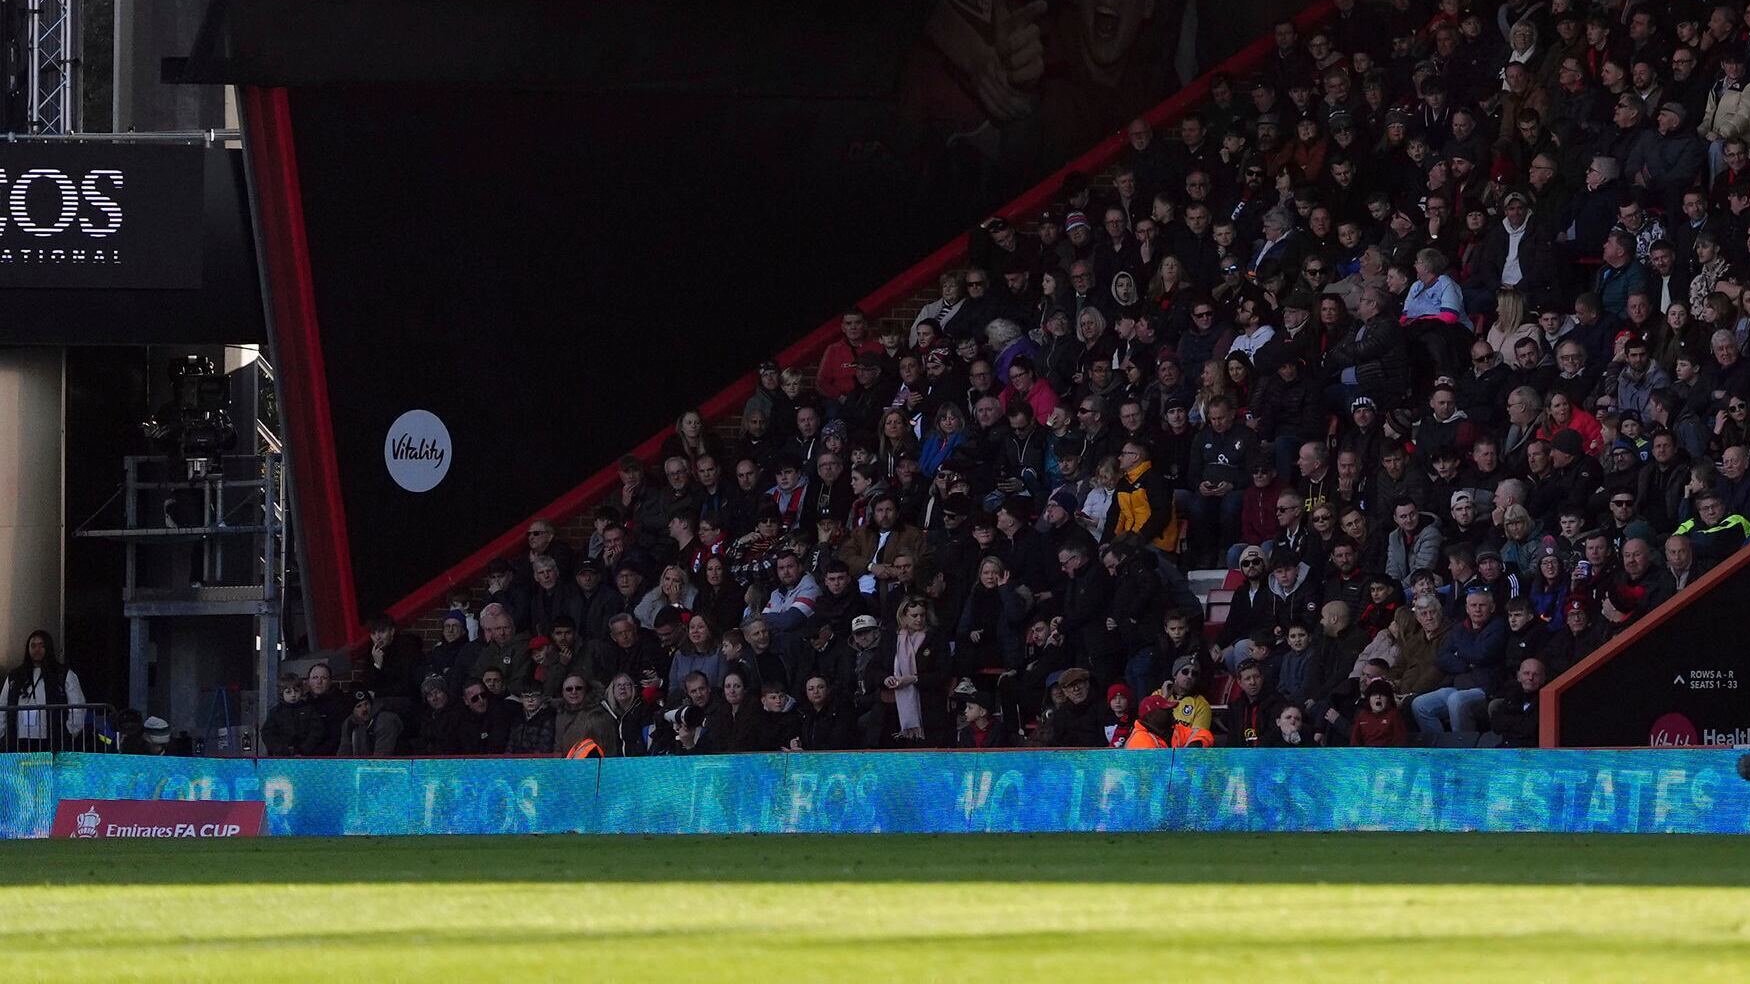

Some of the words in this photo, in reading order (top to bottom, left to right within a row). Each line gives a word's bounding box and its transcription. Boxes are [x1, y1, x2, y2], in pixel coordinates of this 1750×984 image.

[392, 433, 445, 468] Vitality
[1690, 670, 1714, 679] ROWS
[1716, 670, 1722, 679] A
[1728, 670, 1734, 679] R
[1690, 680, 1714, 689] SEATS
[1728, 680, 1738, 689] 33
[106, 824, 172, 838] Emirates
[173, 824, 197, 838] FA
[200, 824, 240, 838] CUP
